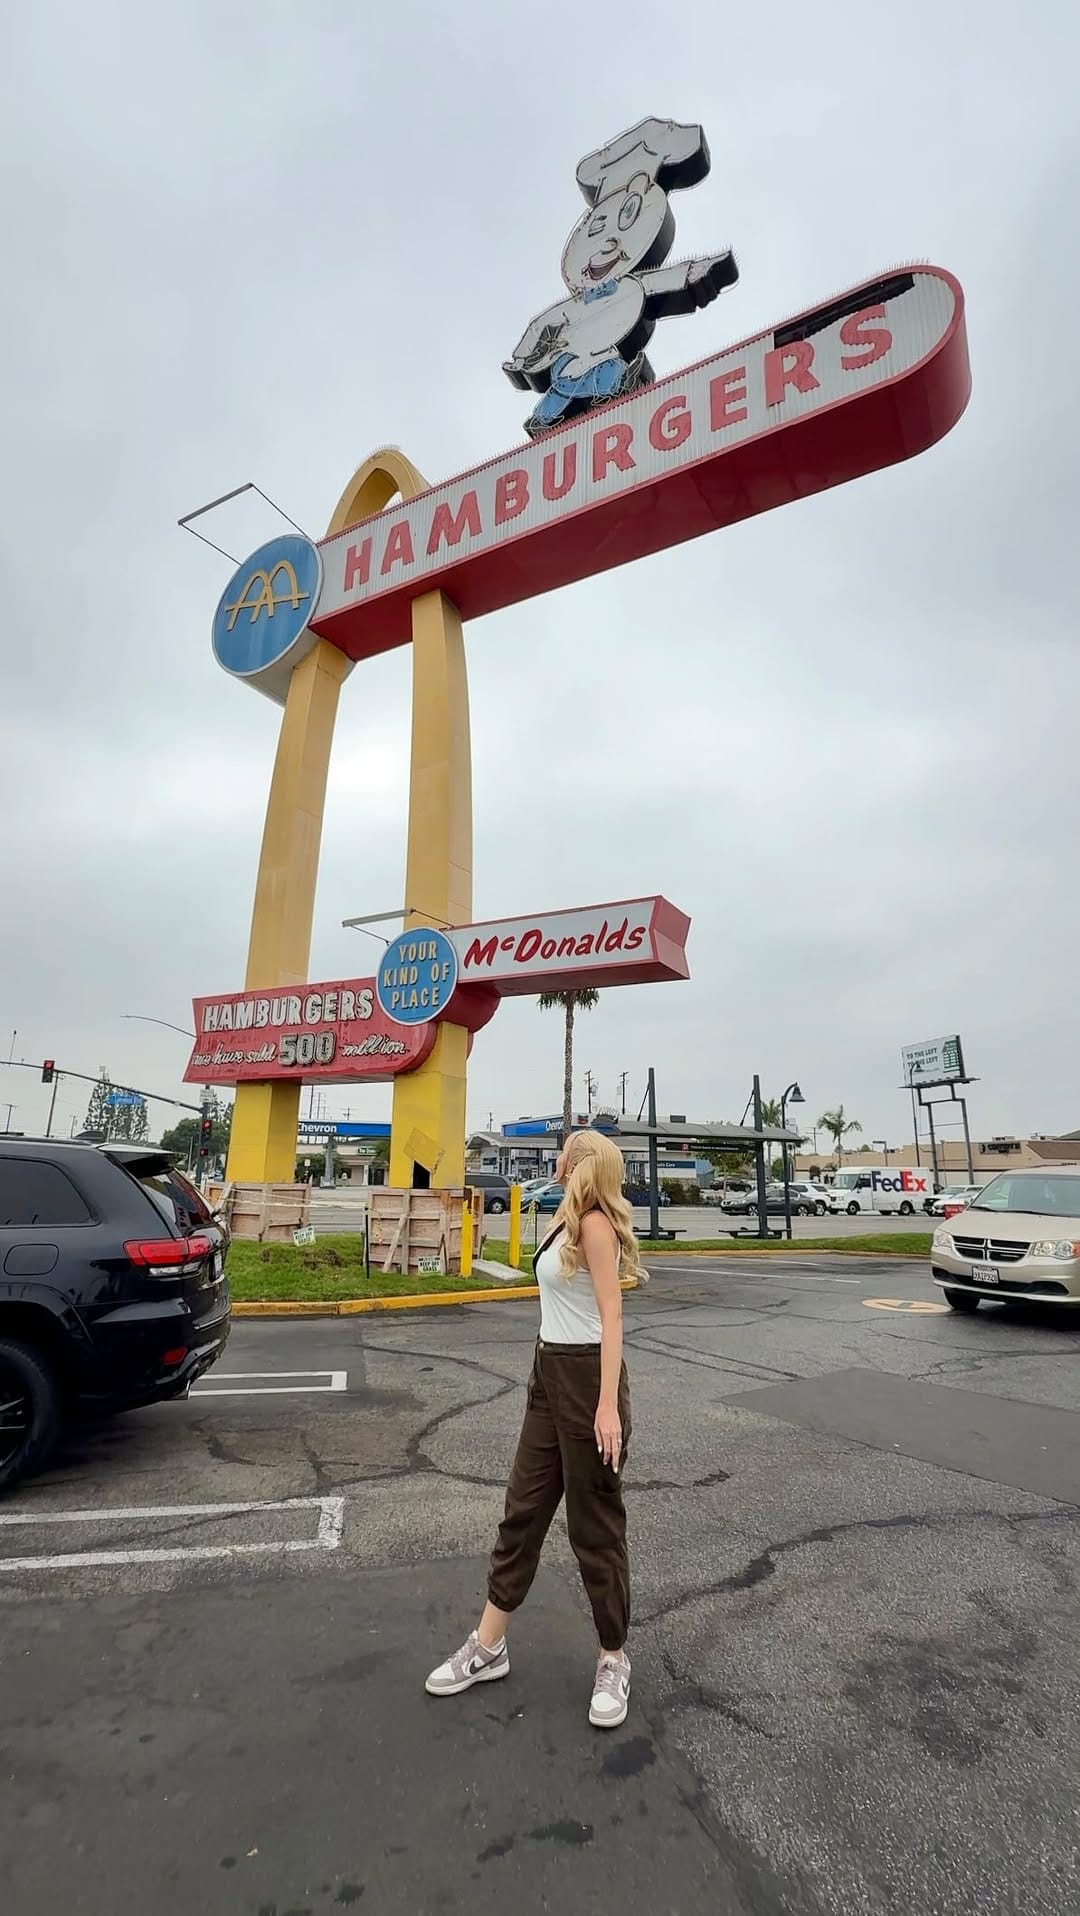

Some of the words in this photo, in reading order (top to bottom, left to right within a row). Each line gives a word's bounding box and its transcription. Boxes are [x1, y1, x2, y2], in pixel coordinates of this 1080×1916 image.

[343, 303, 893, 592] HAMBURGERS
[399, 941, 438, 963] YOUR
[463, 917, 647, 969] McDonalds
[383, 966, 418, 988] KIND
[431, 962, 451, 983] OF
[203, 988, 373, 1033] HAMBURGERS
[391, 987, 440, 1010] PLACE
[211, 1041, 244, 1065] have
[246, 1041, 277, 1064] sold
[279, 1030, 336, 1067] 500
[341, 1033, 407, 1057] million
[914, 1050, 924, 1058] THE
[925, 1047, 937, 1056] LEFT
[926, 1056, 938, 1065] LEFT
[871, 1170, 927, 1192] FedEx
